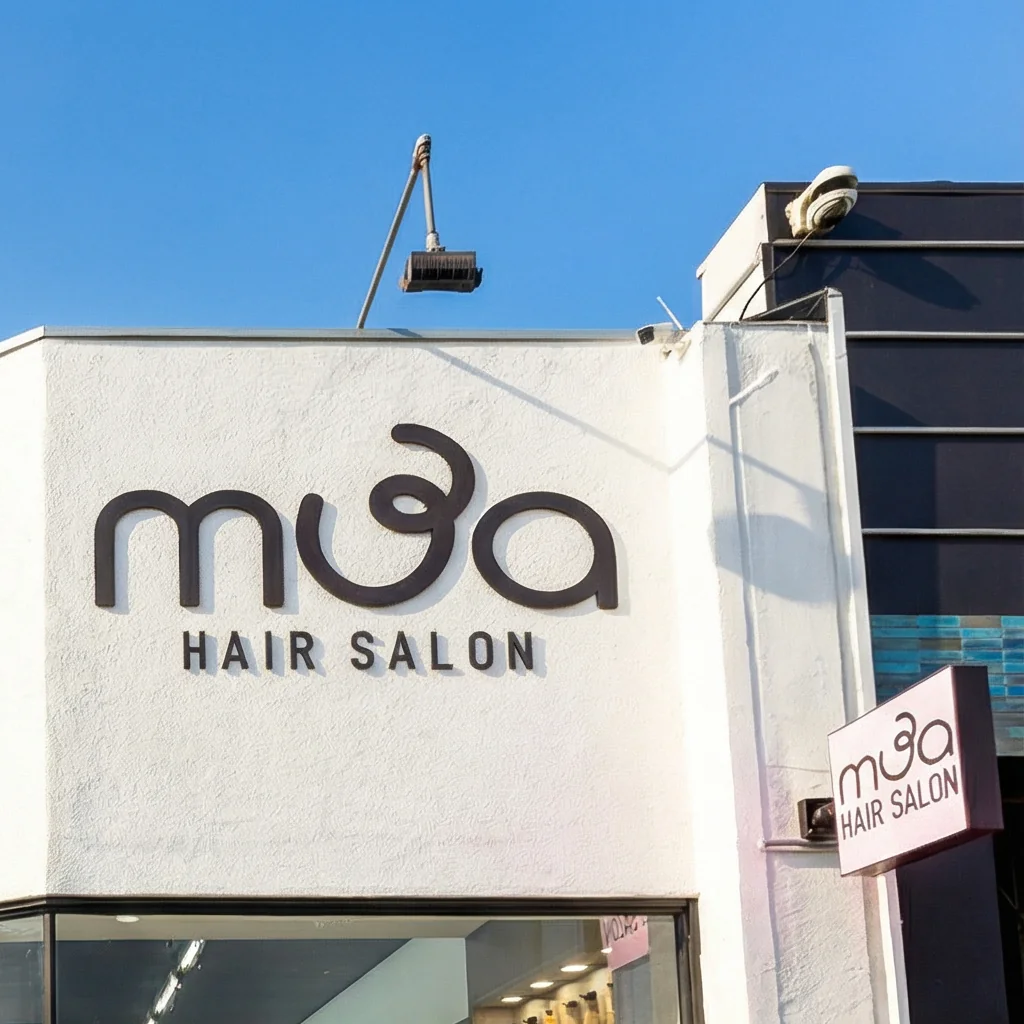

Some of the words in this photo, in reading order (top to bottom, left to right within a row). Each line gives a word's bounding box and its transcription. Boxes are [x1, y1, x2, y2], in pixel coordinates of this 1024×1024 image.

[183, 630, 316, 671] HAIR
[350, 630, 534, 671] SALON
[840, 798, 885, 841] HAIR
[890, 764, 959, 819] SALON
